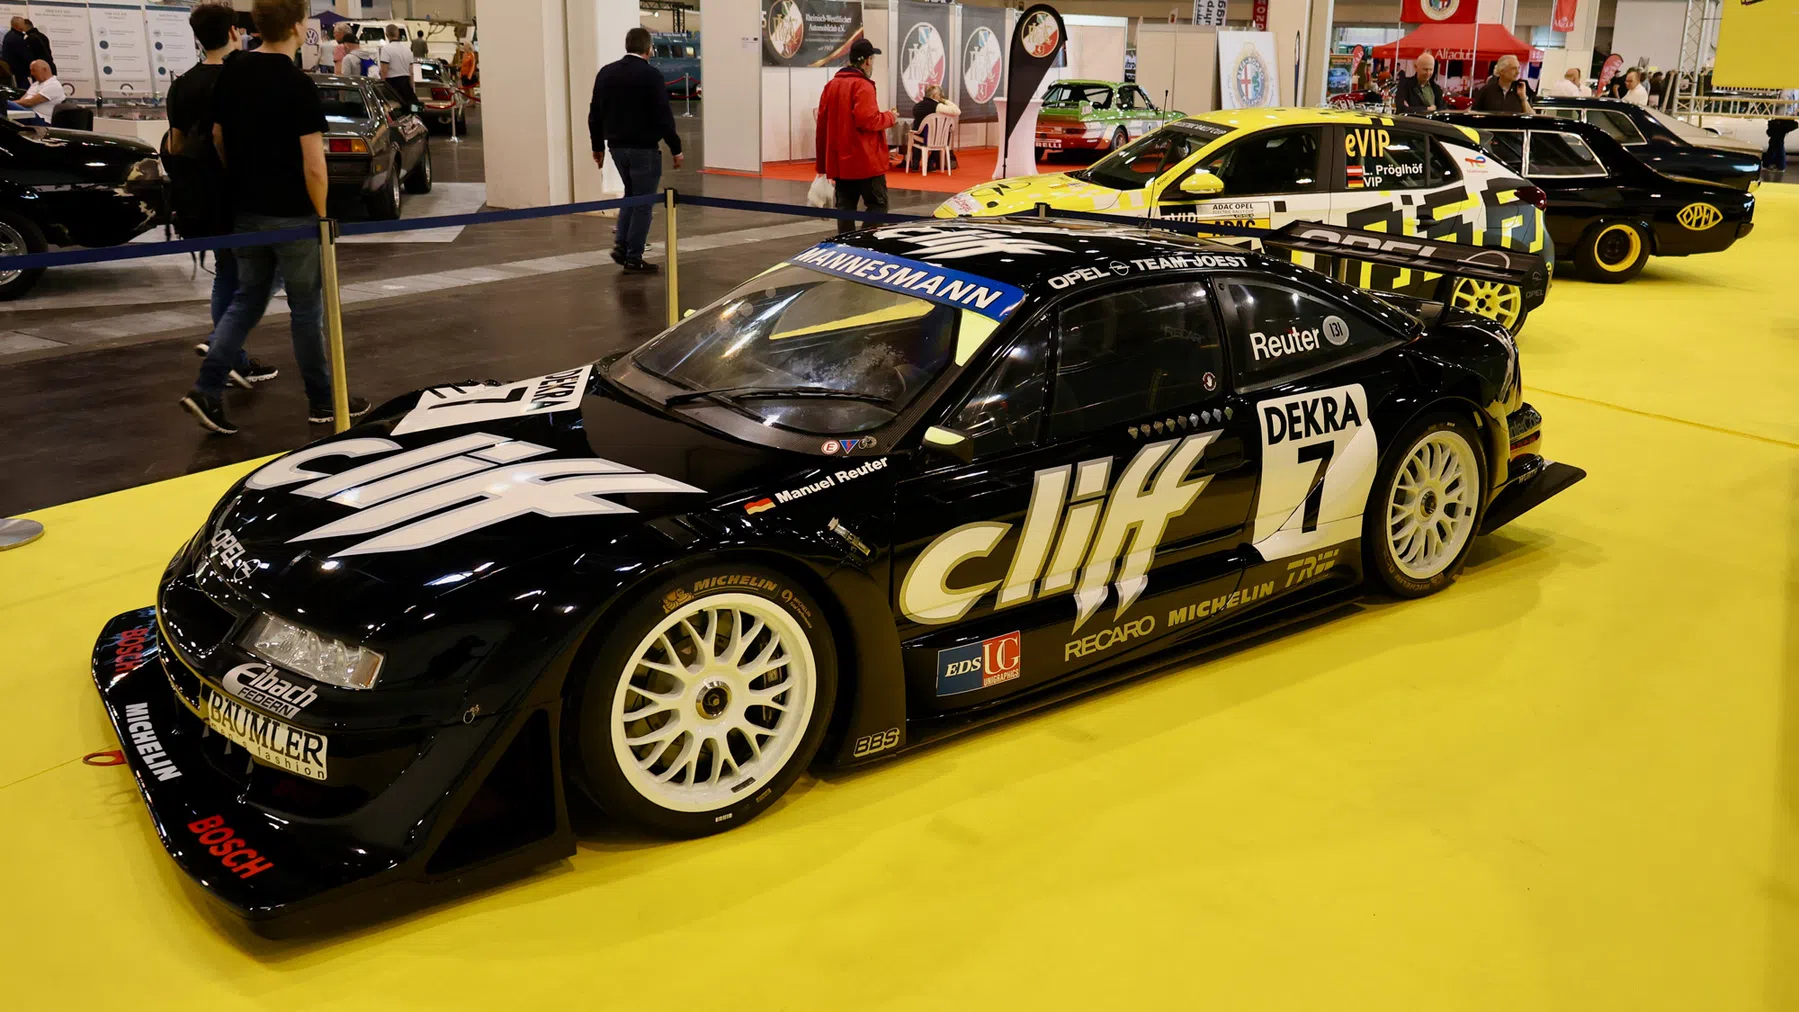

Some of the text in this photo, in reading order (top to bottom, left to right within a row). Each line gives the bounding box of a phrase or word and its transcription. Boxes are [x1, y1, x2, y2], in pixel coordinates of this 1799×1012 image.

[1345, 129, 1391, 158] eVIP
[1362, 163, 1423, 178] L. Pröglhöf
[1363, 176, 1383, 188] VIP
[1682, 205, 1716, 228] OPEL
[794, 247, 1003, 310] MANNESMANN
[1048, 255, 1249, 290] OPEL TEAM JOEST
[1525, 289, 1544, 298] OPEL
[1250, 326, 1320, 360] Reuter
[526, 368, 584, 412] DEKRA
[1264, 391, 1363, 445] DEKRA
[245, 431, 709, 559] cliff
[775, 456, 888, 504] Manuel Reuter
[1297, 440, 1335, 534] 7
[210, 528, 246, 571] OPEL
[899, 428, 1225, 635] cliff
[693, 574, 778, 592] MICHELIN
[1285, 548, 1340, 589] TRW
[1167, 581, 1275, 627] MICHELIN
[115, 627, 149, 673] BOSCH
[983, 637, 1021, 675] UG
[1064, 615, 1156, 662] RECARO
[222, 662, 318, 709] Eibach
[944, 656, 983, 678] EDS
[983, 668, 1020, 686] UNIGRAPHICS
[237, 687, 298, 718] FEDERN
[125, 702, 183, 783] MICHELIN
[210, 689, 324, 768] BÄUMLER
[854, 727, 900, 758] BBS
[257, 744, 326, 779] fashion
[187, 815, 275, 880] BOSCH
